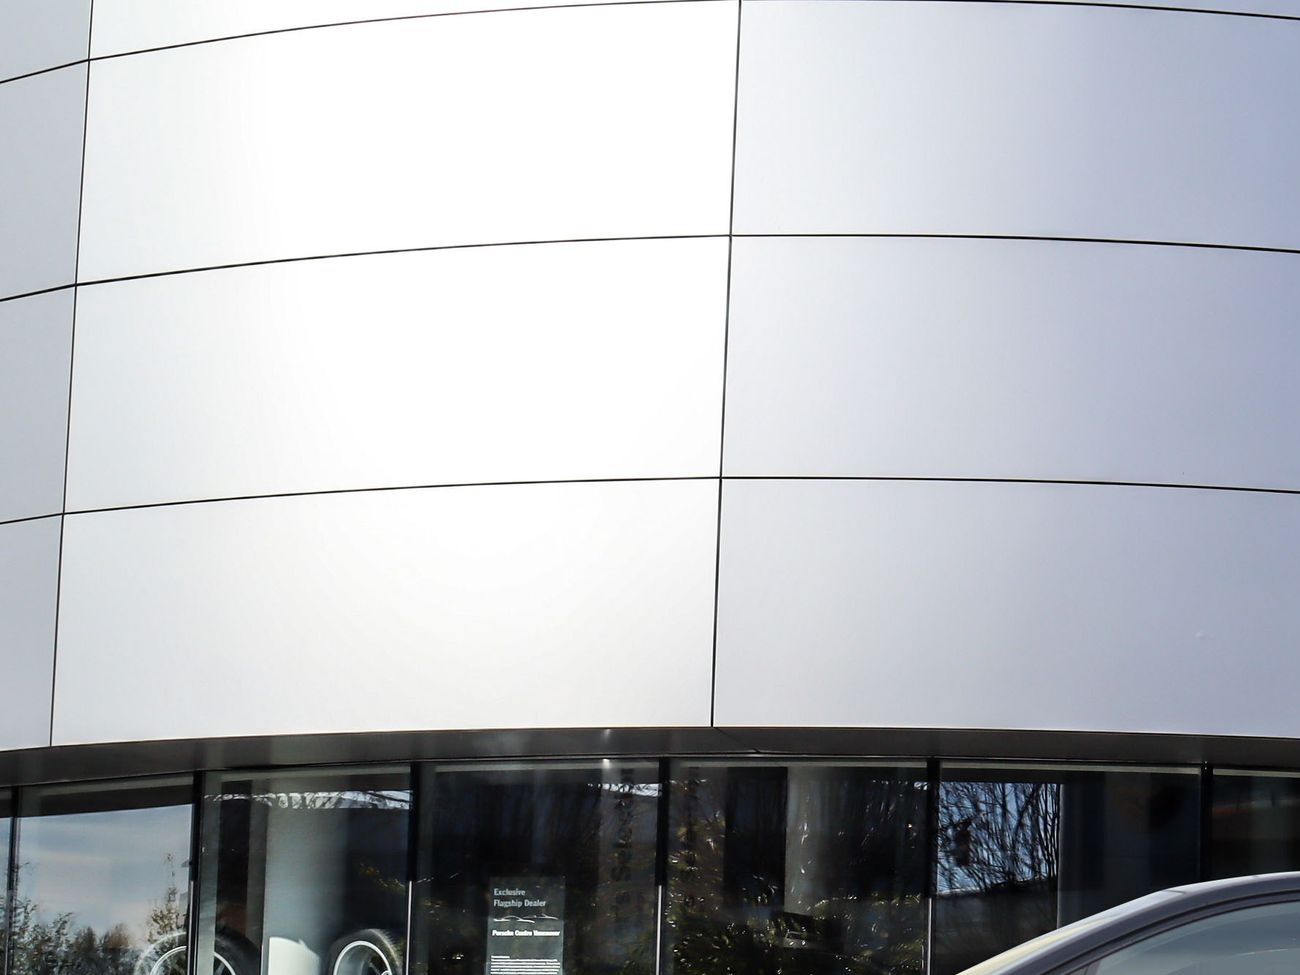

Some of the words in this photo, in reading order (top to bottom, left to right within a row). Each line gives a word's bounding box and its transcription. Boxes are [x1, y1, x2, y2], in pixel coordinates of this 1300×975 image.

[493, 888, 526, 896] Exclusive
[493, 899, 522, 908] Flagship
[524, 899, 547, 907] Dealer
